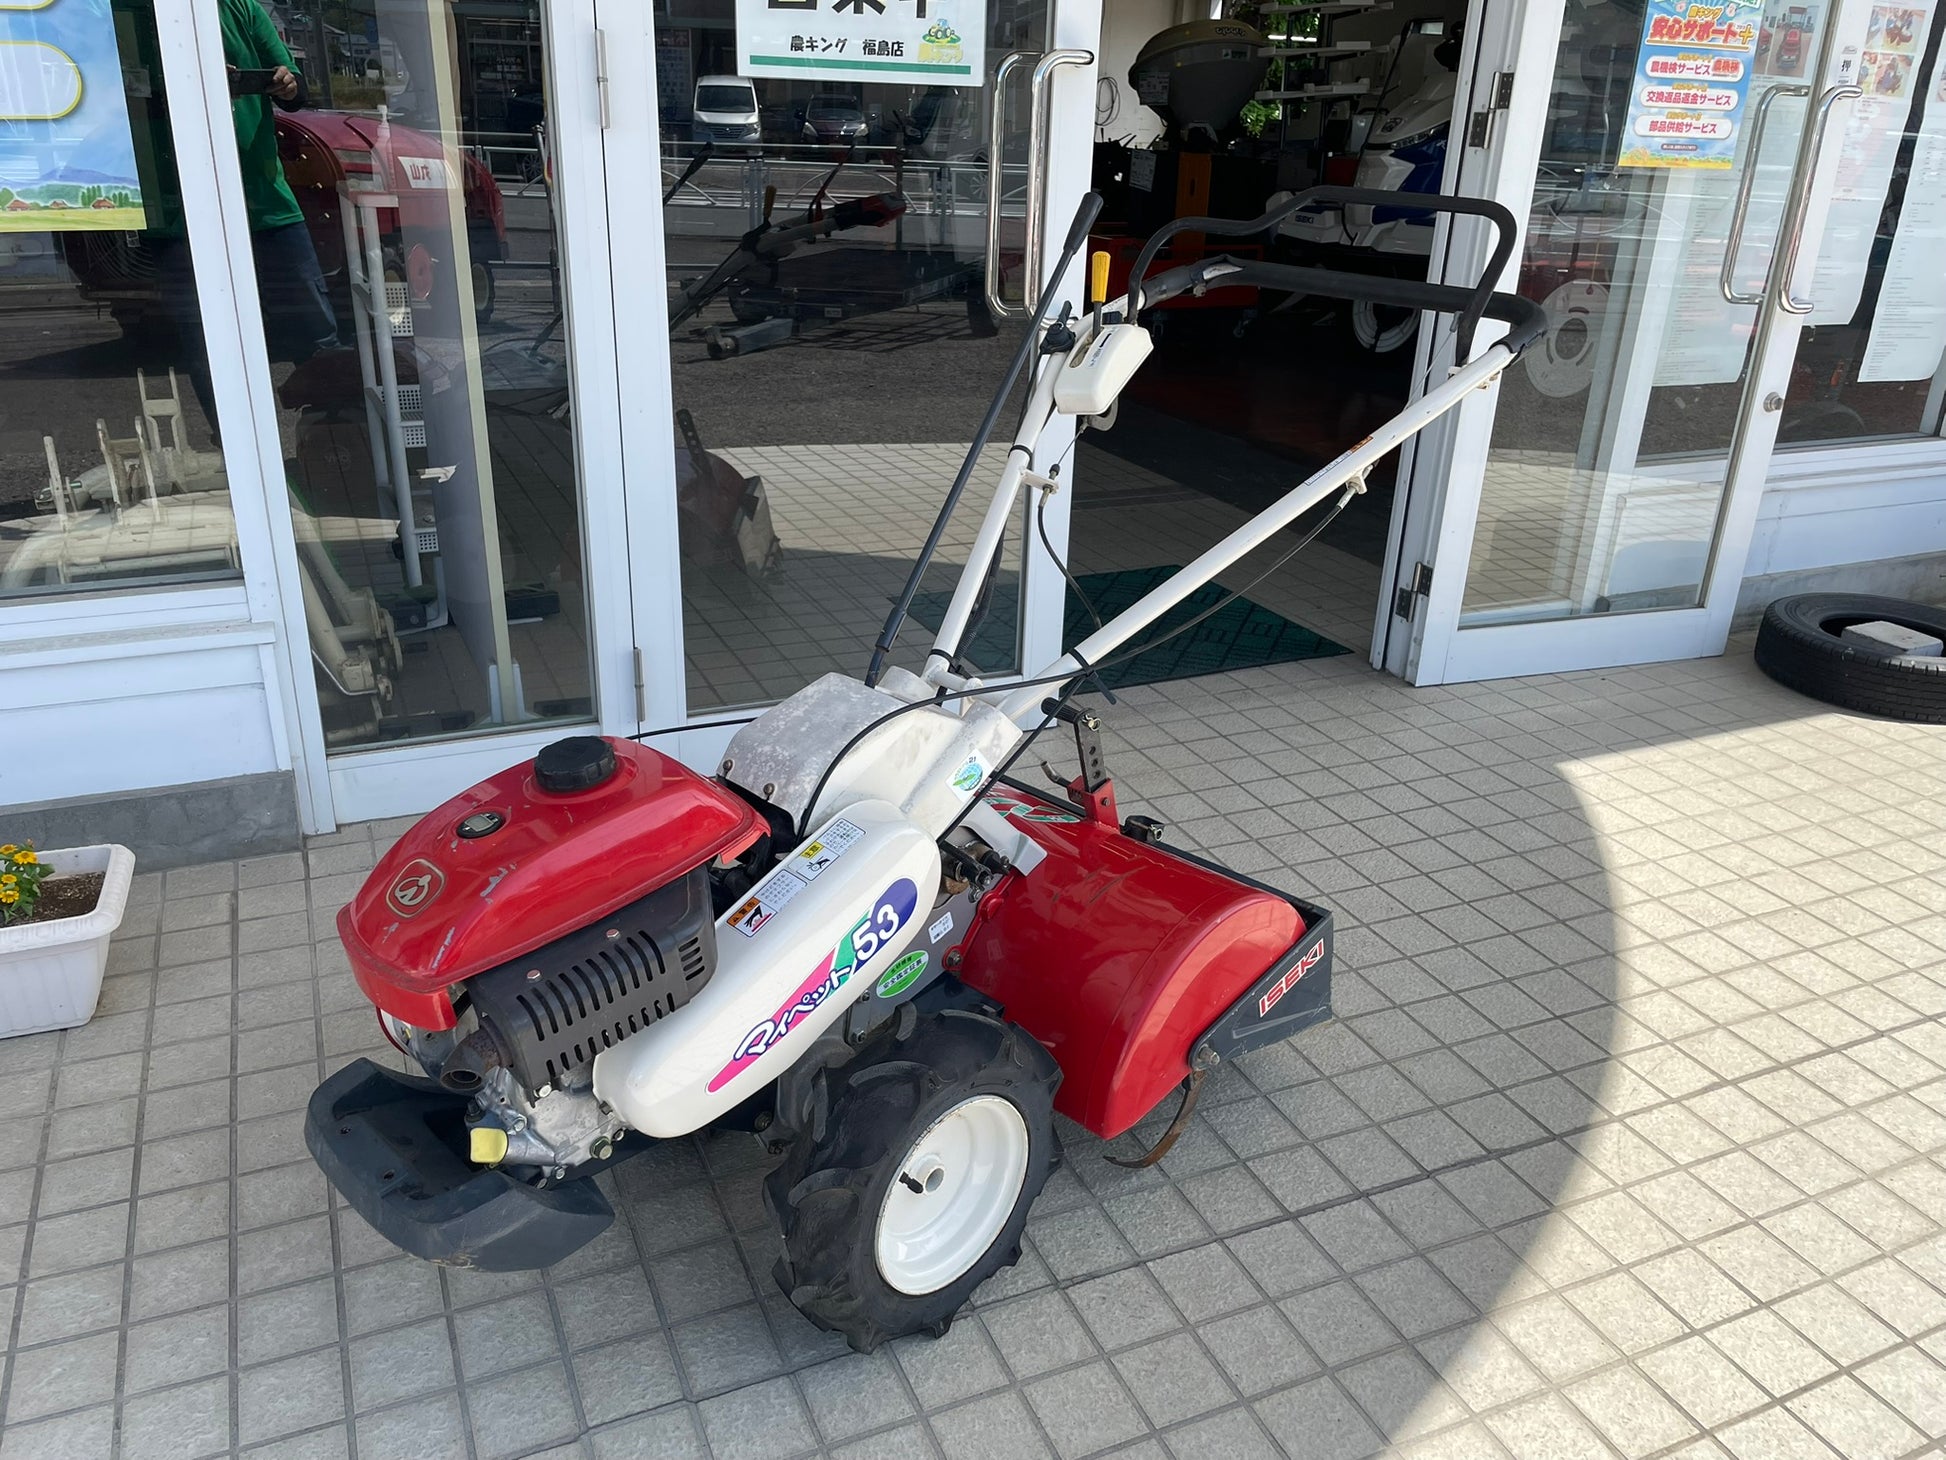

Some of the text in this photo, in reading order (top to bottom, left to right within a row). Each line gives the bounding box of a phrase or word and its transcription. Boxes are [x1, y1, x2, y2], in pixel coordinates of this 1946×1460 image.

[791, 35, 904, 57] 農キング 福島店
[1646, 90, 1732, 106] 交換返品返金サービス
[1649, 120, 1717, 134] 部品供給サービス
[852, 903, 899, 961] 53
[1259, 939, 1324, 1017] ISEKI
[734, 966, 851, 1061] マイペット
